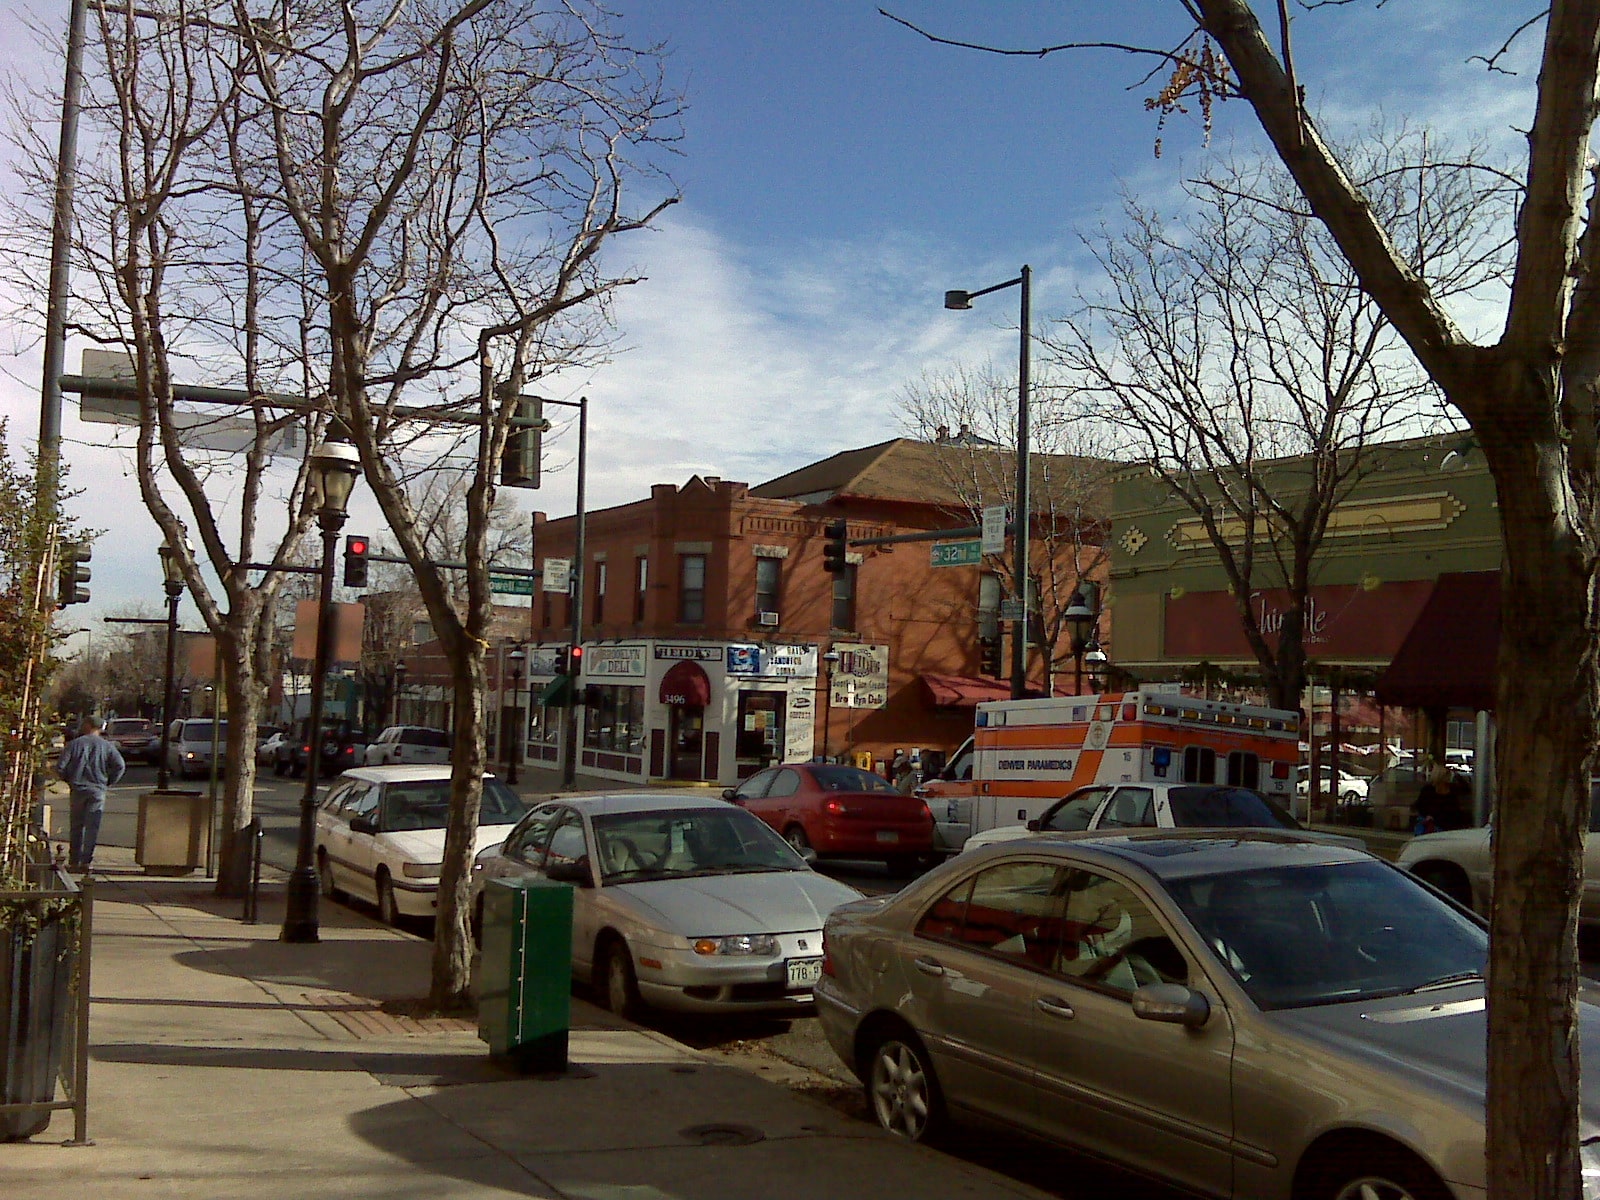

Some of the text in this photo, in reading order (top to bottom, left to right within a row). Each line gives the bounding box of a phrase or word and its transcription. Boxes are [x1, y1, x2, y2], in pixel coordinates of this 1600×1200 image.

[608, 660, 629, 673] DELI
[664, 695, 685, 704] 3496
[1123, 751, 1132, 762] 15
[998, 760, 1072, 770] DENVER PARAMEDICS
[1274, 781, 1284, 790] 15
